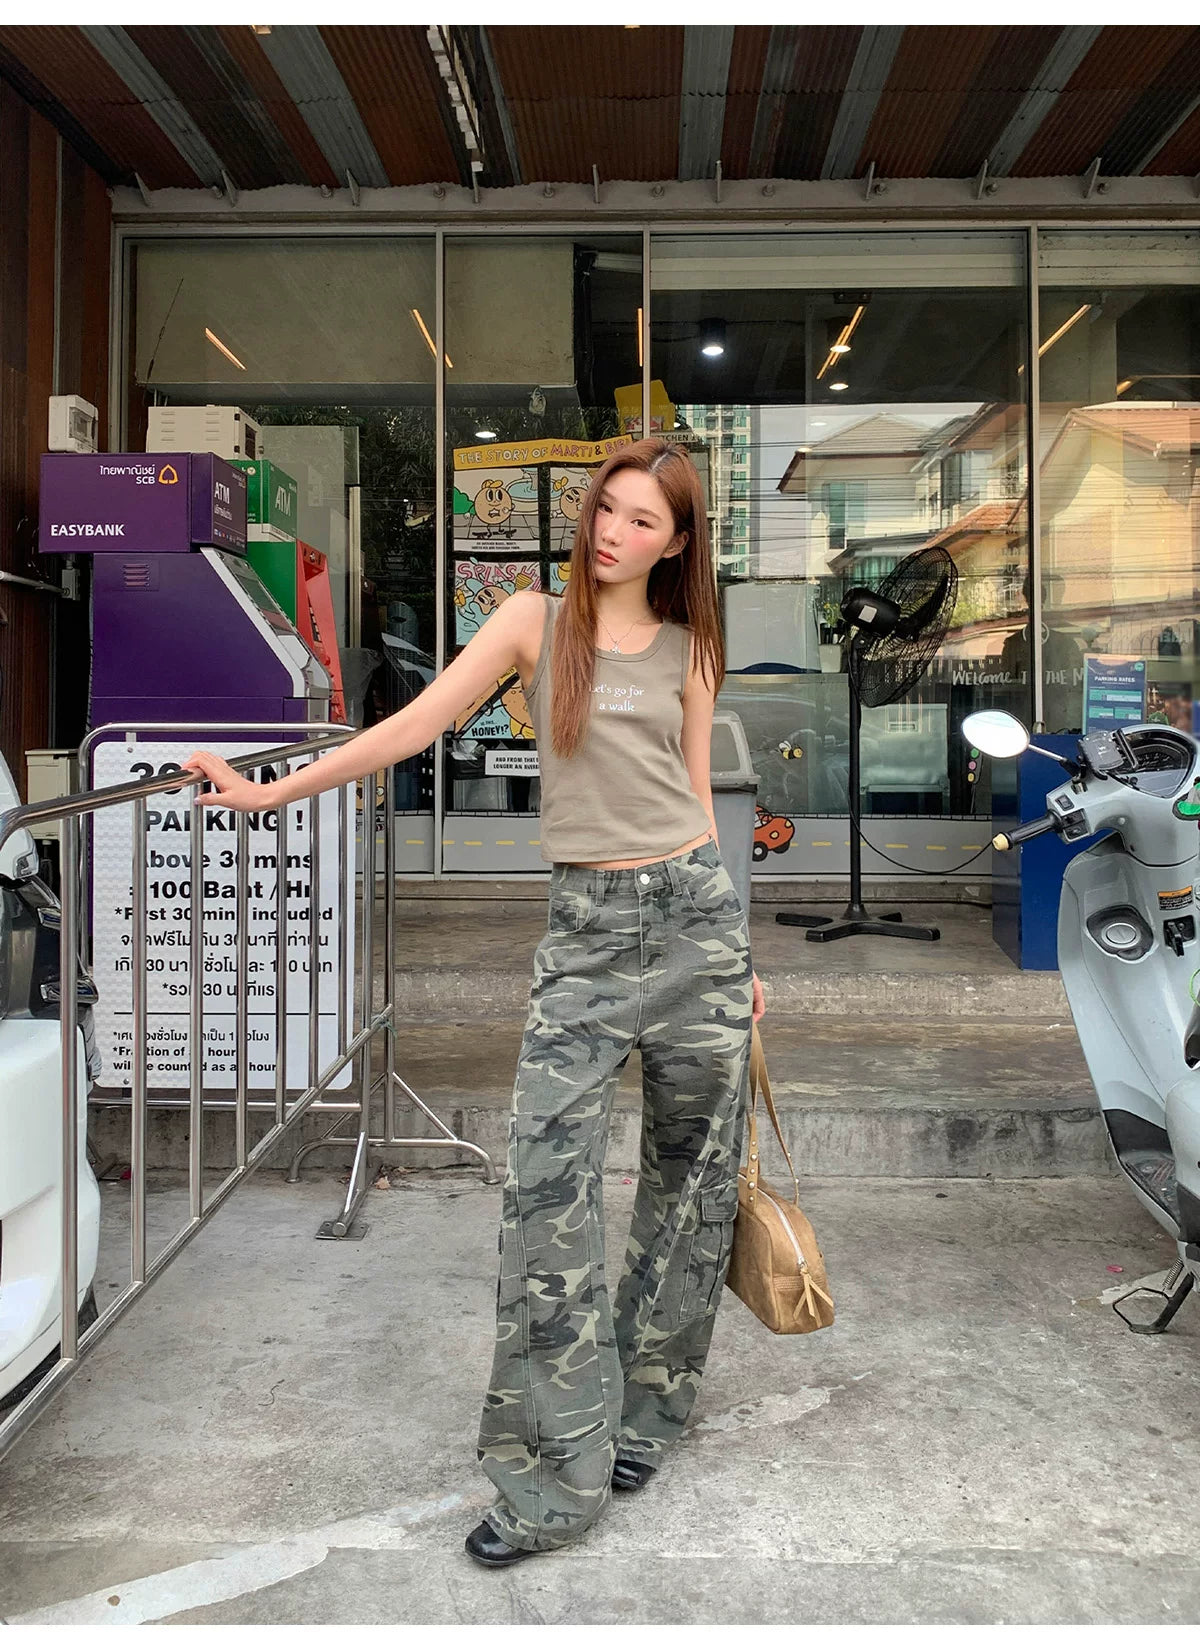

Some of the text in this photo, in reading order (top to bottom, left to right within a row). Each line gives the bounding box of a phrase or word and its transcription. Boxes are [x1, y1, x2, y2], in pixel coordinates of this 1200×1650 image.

[459, 438, 630, 464] THE STORY OF MARTI & BIB
[100, 464, 155, 475] ไทยพาณิชย์
[136, 476, 155, 485] SCB
[214, 481, 230, 504] ATM
[275, 485, 291, 517] ATM
[50, 524, 125, 536] EASYBANK
[1046, 670, 1067, 685] THE
[614, 687, 627, 697] go
[627, 684, 645, 699] for
[599, 700, 635, 711] a walk
[471, 724, 509, 737] HONEY!?
[296, 810, 303, 831] !
[144, 849, 211, 868] bove
[254, 854, 311, 868] mns
[203, 907, 236, 920] min
[252, 907, 333, 920] incudd
[147, 959, 165, 971] 30
[270, 959, 298, 972] 10
[203, 983, 222, 996] 30
[173, 1046, 185, 1056] of
[208, 1047, 236, 1056] hour
[211, 1063, 226, 1071] as
[249, 1062, 277, 1071] hour
